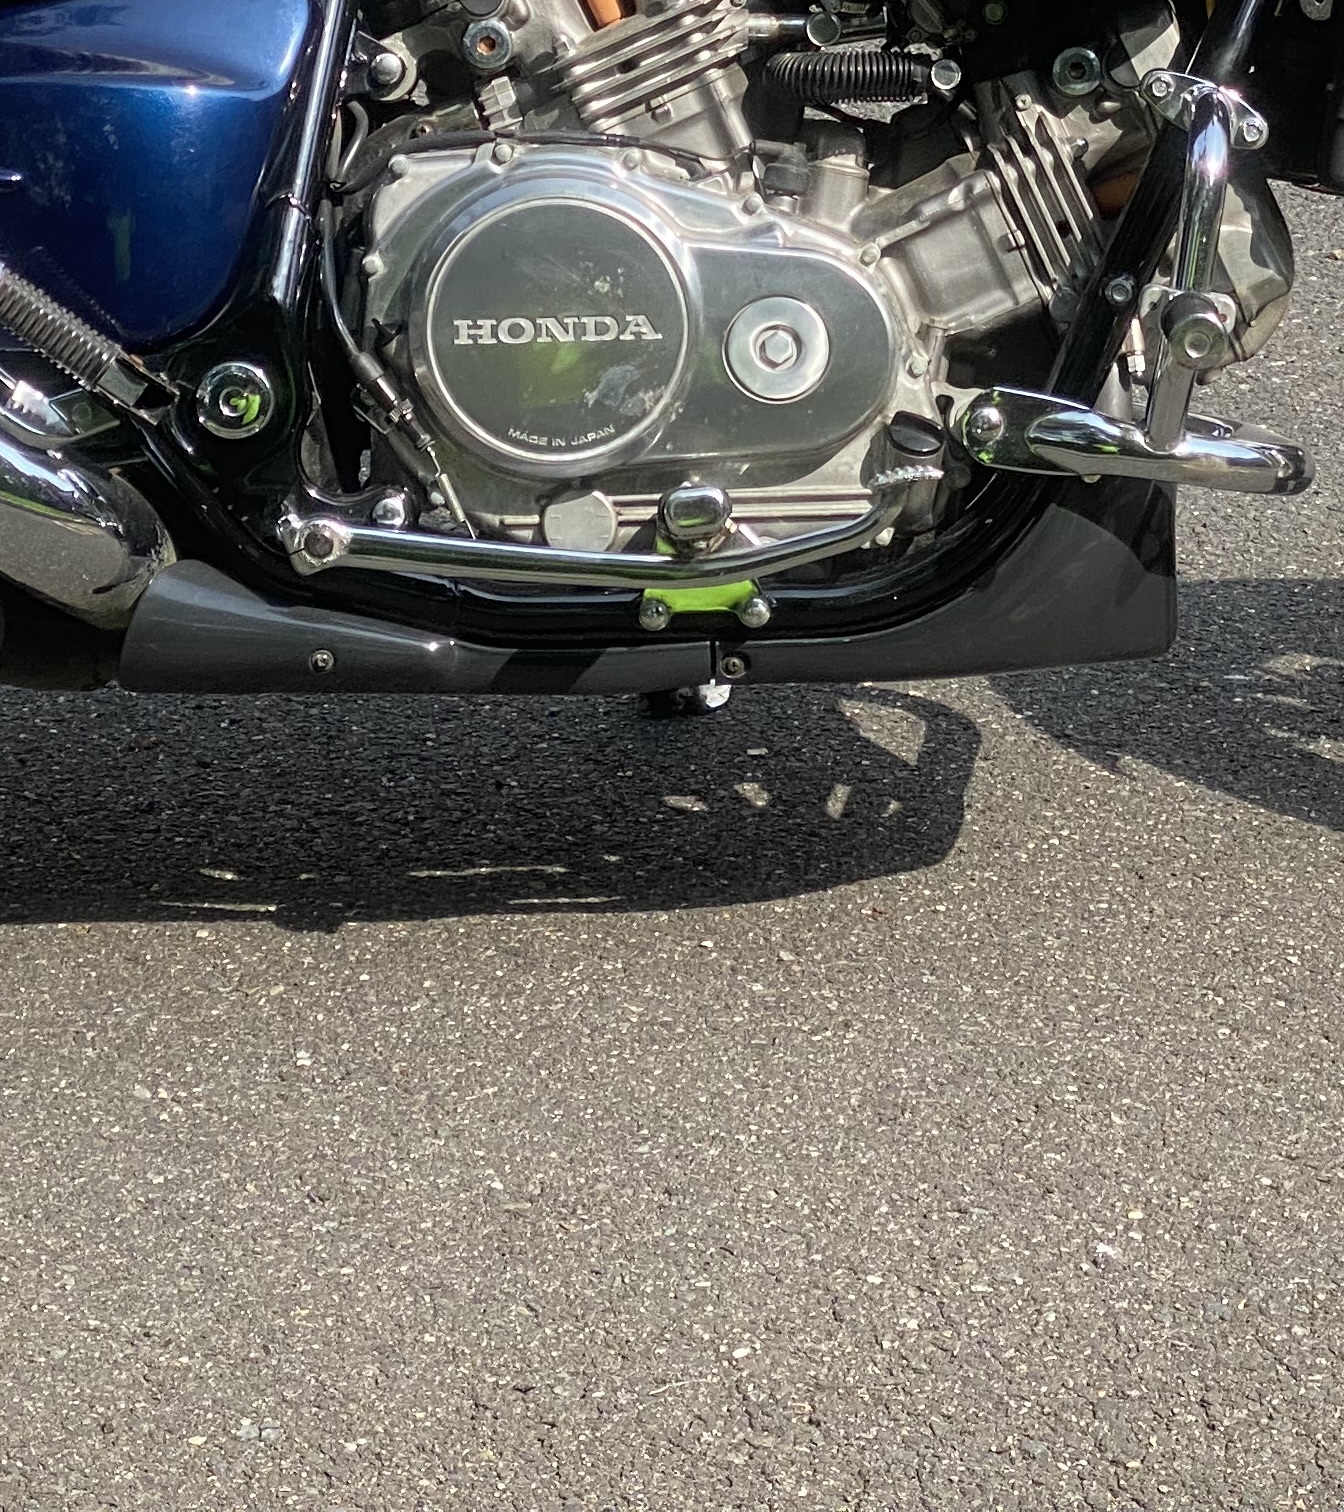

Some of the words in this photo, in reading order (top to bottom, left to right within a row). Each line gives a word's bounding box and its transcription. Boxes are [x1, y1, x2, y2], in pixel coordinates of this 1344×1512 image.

[452, 313, 663, 346] HONDA
[507, 428, 548, 446] MADE
[551, 437, 566, 447] IN
[570, 423, 615, 446] JAPAN
